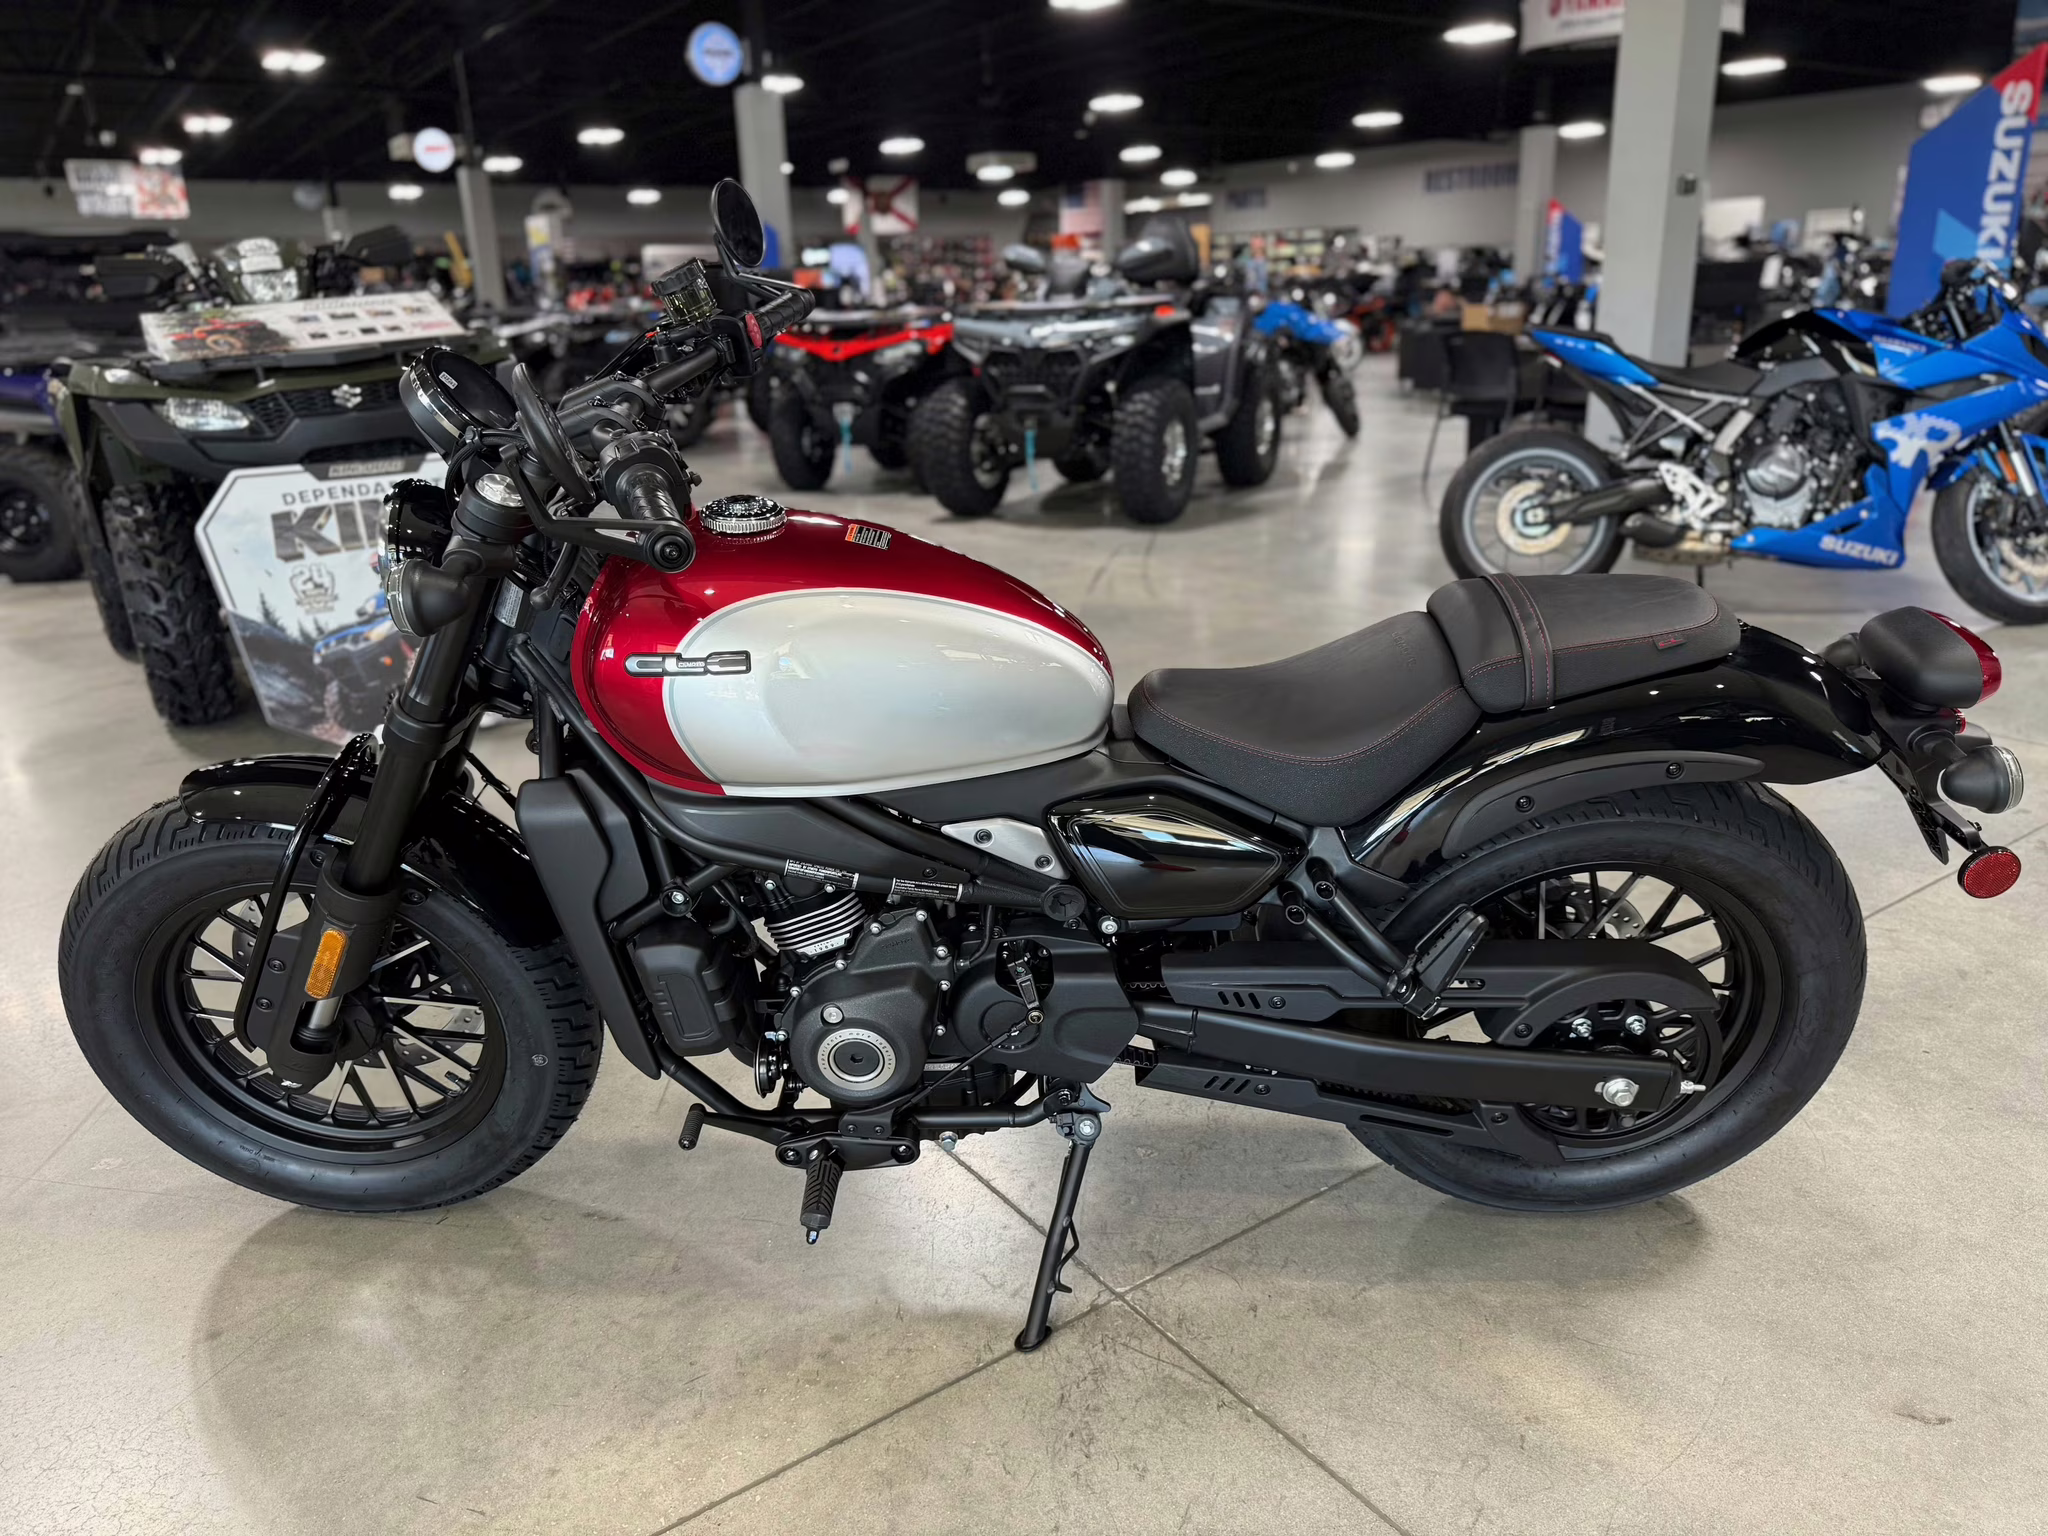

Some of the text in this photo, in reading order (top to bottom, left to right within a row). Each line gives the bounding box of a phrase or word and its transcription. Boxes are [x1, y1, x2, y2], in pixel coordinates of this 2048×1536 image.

[1976, 80, 2034, 260] SUZUKI
[1818, 535, 1899, 566] SUZUKI
[820, 1034, 843, 1070] experience
[875, 1039, 893, 1070] together
